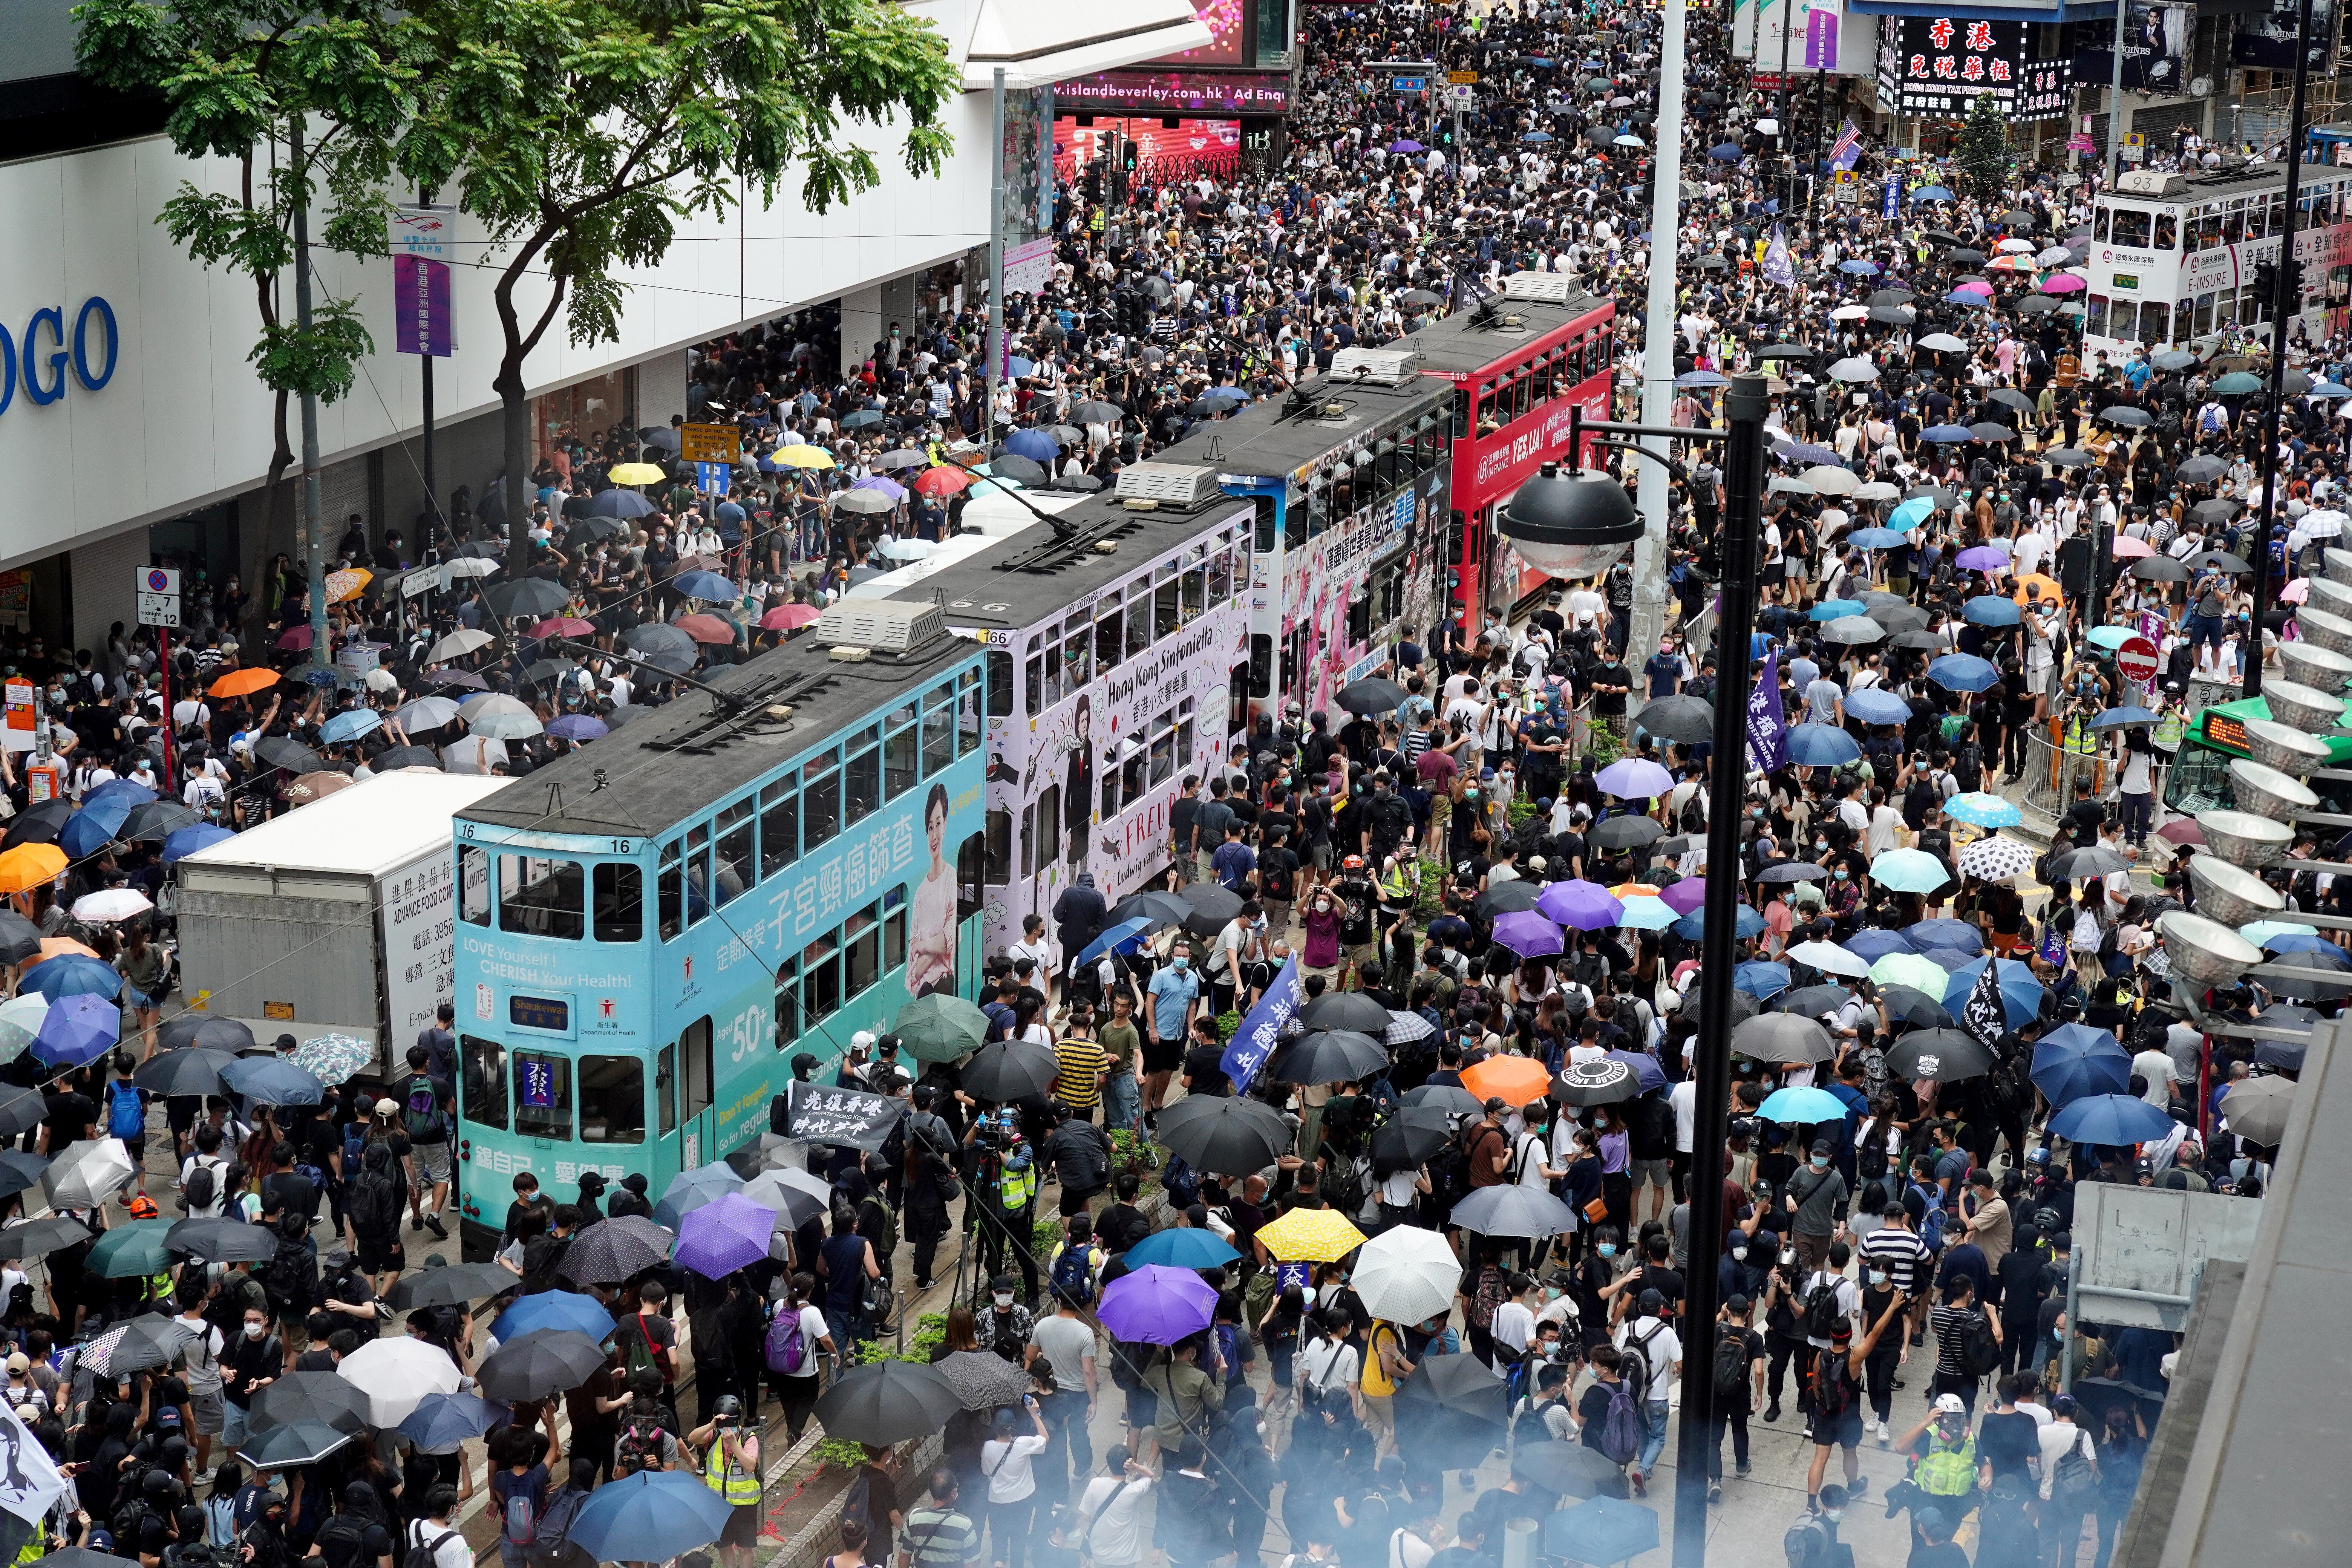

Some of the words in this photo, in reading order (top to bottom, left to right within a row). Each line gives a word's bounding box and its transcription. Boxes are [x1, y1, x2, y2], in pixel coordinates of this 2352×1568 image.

[1818, 14, 1826, 67] 香港亞洲國際都會
[1929, 18, 1996, 51] 香港
[1903, 83, 1924, 92] HONG
[1925, 84, 1946, 93] KONG
[1946, 85, 1961, 94] TAX
[2035, 70, 2056, 91] 香港
[1234, 89, 1252, 99] Ad
[1903, 96, 1951, 109] 政府註冊
[2133, 176, 2153, 190] 93
[2115, 253, 2154, 263] 招商永隆保險
[2188, 271, 2227, 292] E-INSURE
[417, 262, 430, 352] 香港亞洲國際都會
[1450, 372, 1467, 381] 116
[1488, 466, 1493, 478] UA
[1494, 457, 1509, 476] FINANCE
[1244, 476, 1257, 485] 41
[1373, 502, 1394, 544] 必去
[1395, 489, 1414, 533] 德島
[1334, 565, 1357, 586] EXPERIENCE
[1358, 554, 1372, 570] UNIQUE
[1372, 542, 1393, 560] TOKUSHIMA
[1394, 534, 1406, 547] JAPAN
[163, 597, 171, 607] 7
[1076, 591, 1098, 608] VOTRUBA
[164, 614, 177, 625] 12
[984, 631, 1006, 643] 166
[1108, 682, 1133, 708] Hong
[1136, 663, 1159, 691] Kong
[1161, 627, 1213, 673] Sinfonietta
[1133, 669, 1188, 724] 香港小交響樂團
[7, 703, 15, 711] 8P
[15, 704, 24, 712] N8P
[462, 824, 474, 838] 16
[611, 840, 630, 854] 16
[1117, 861, 1141, 886] Ludwig
[1143, 851, 1155, 867] van
[1157, 838, 1169, 858] Bee
[394, 902, 421, 926] ADVANCE
[421, 891, 438, 913] FOOD
[466, 867, 488, 890] LIMITED
[716, 918, 766, 974] 定期接受
[768, 813, 914, 951] 子宮頸癌篩查
[434, 917, 453, 942] 3956
[464, 937, 495, 958] LOVE
[496, 946, 550, 967] Yourself
[480, 959, 538, 982] CHERISH
[541, 971, 574, 987] Your
[577, 973, 632, 988] Health!
[514, 999, 568, 1016] Shaukeiwan
[674, 995, 689, 1009] Department
[694, 986, 703, 998] Health
[717, 1020, 733, 1041] Aged
[802, 1090, 882, 1116] 光復香港
[791, 1118, 870, 1136] 時代革命
[719, 1138, 728, 1152] Go
[729, 1130, 740, 1146] for
[475, 1145, 531, 1175] 錫自己
